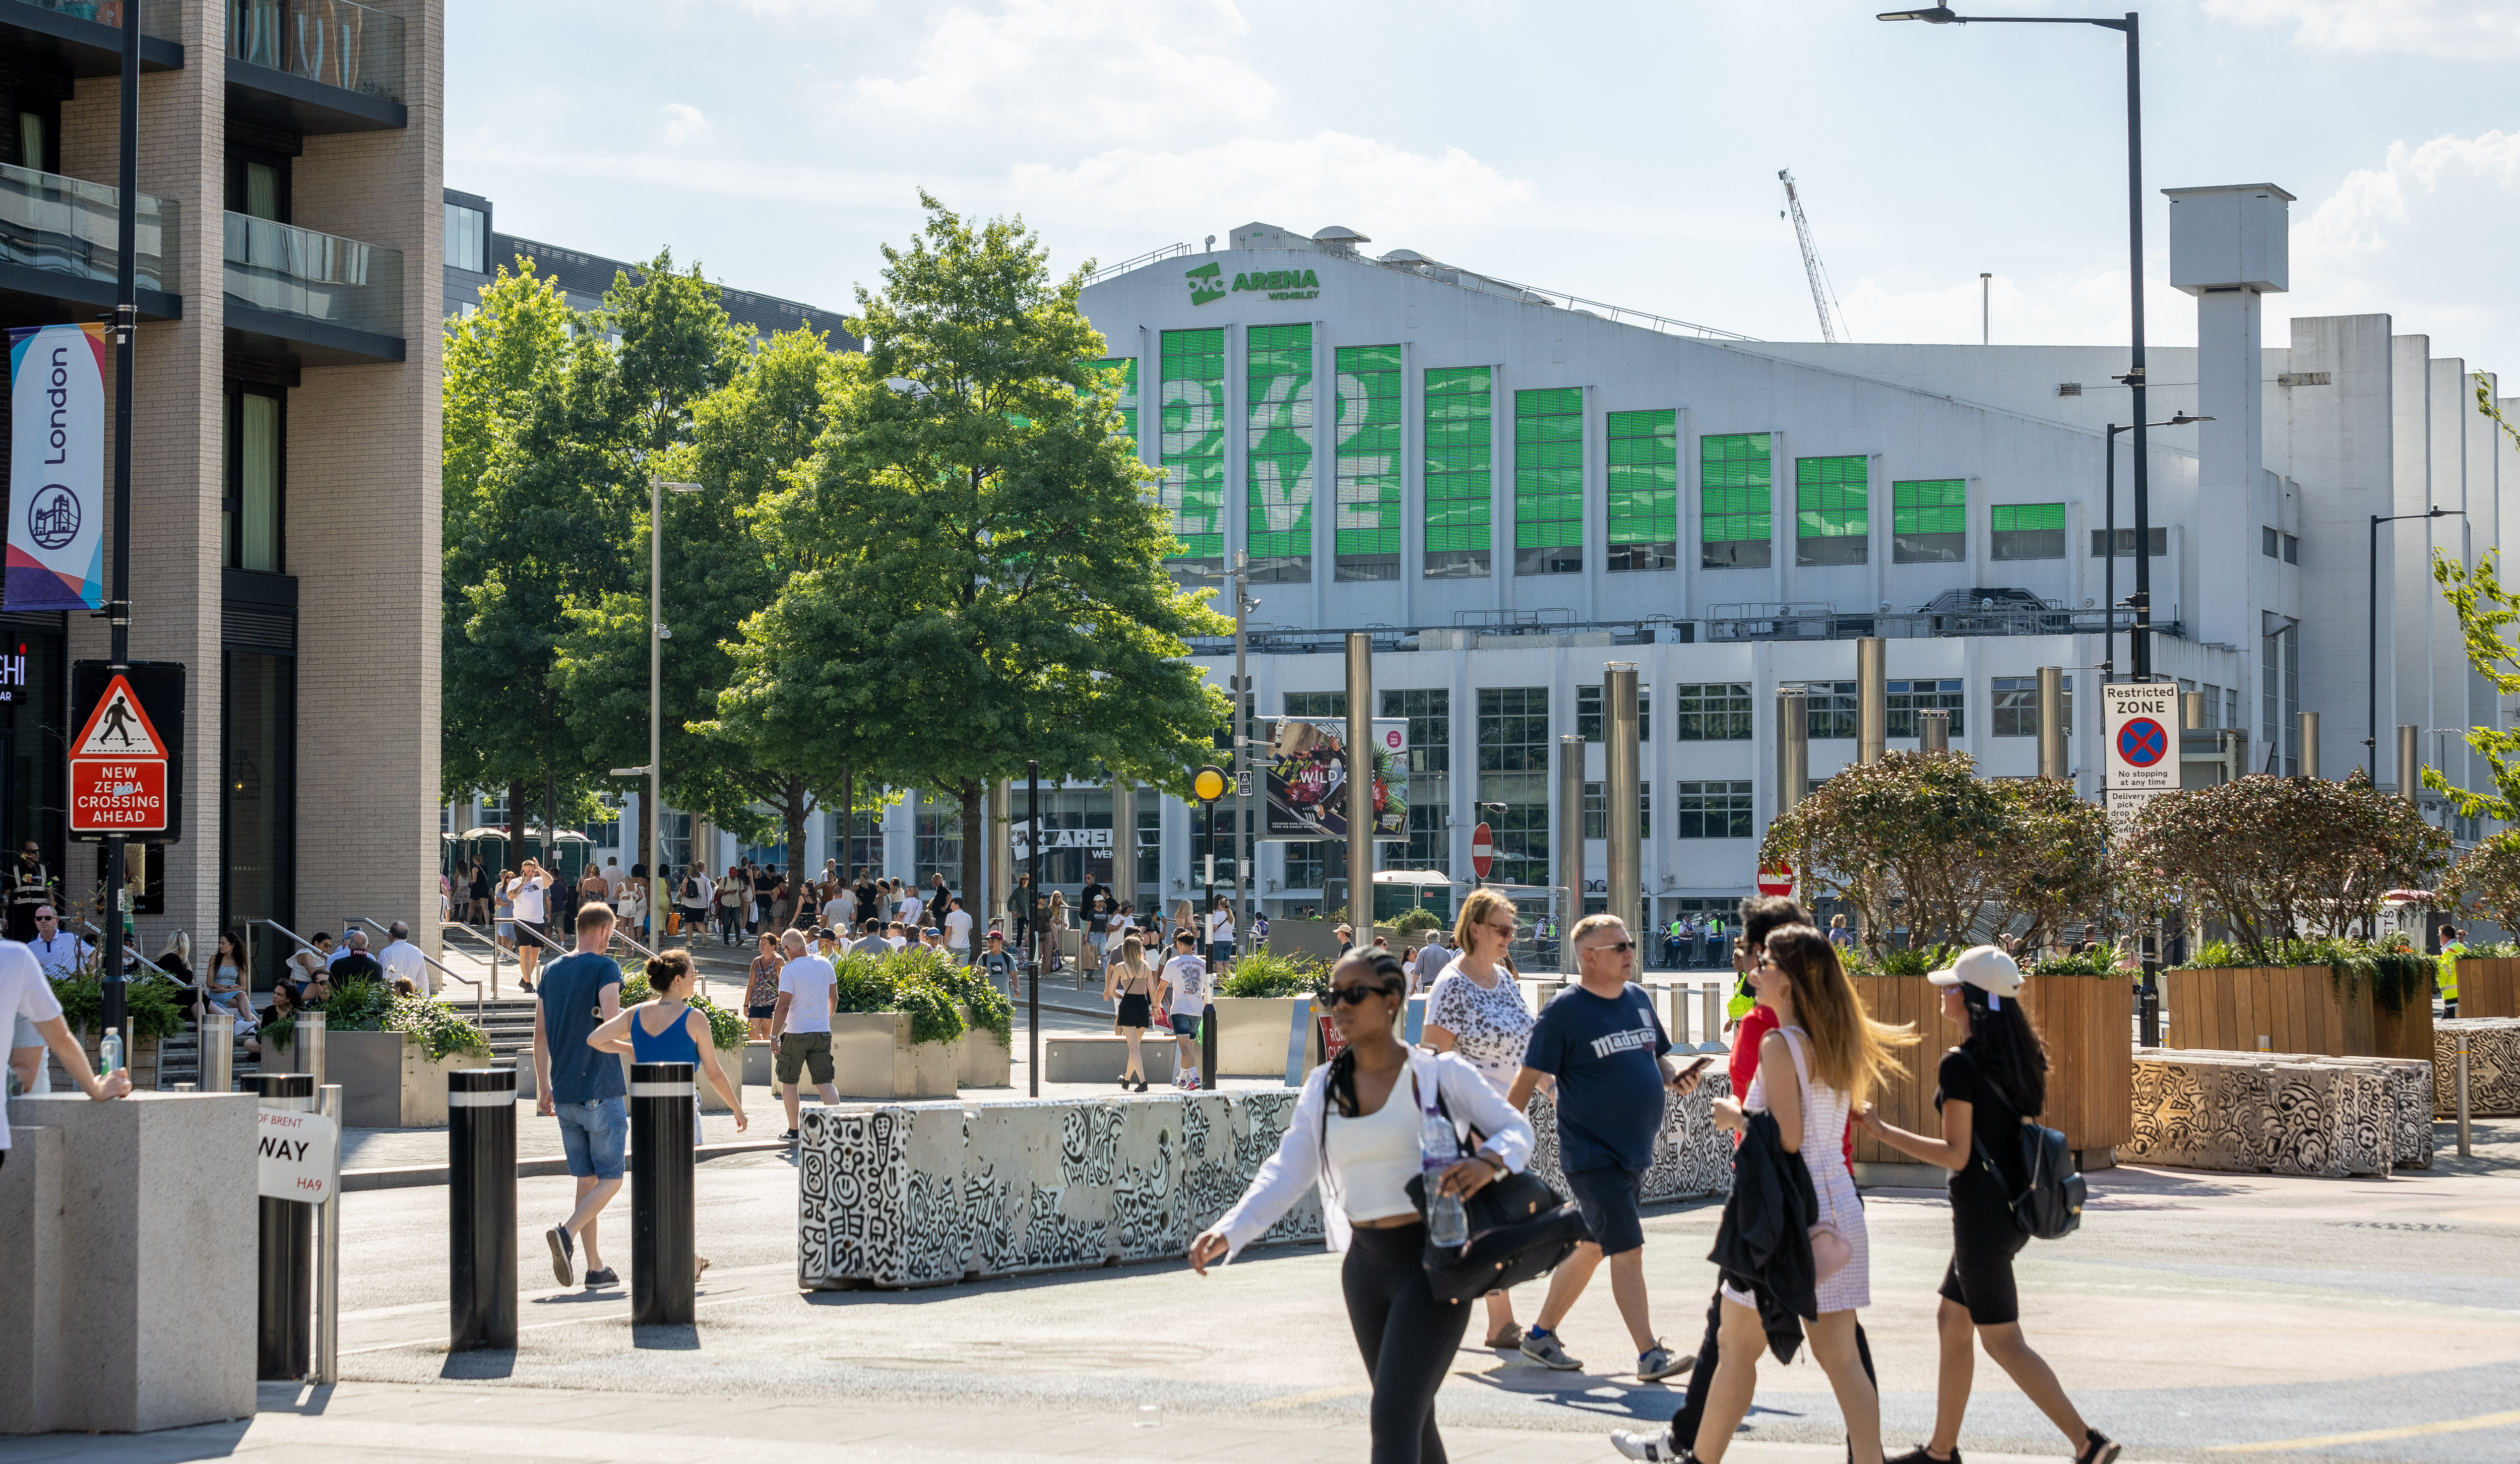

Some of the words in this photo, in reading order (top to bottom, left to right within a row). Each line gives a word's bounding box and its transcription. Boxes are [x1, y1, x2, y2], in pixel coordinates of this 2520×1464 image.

[1232, 269, 1319, 291] ARENA
[1269, 290, 1319, 300] WEMBLEY
[44, 348, 67, 465] London
[2107, 686, 2174, 698] Restricted
[2117, 701, 2165, 714] ZONE
[102, 767, 137, 779] NEW
[2132, 770, 2168, 778] stopping
[78, 796, 159, 808] CROSSING
[92, 810, 145, 822] AHEAD
[1176, 961, 1191, 969] TOKYO
[271, 1115, 304, 1129] BRENT
[296, 1177, 322, 1191] HA9
